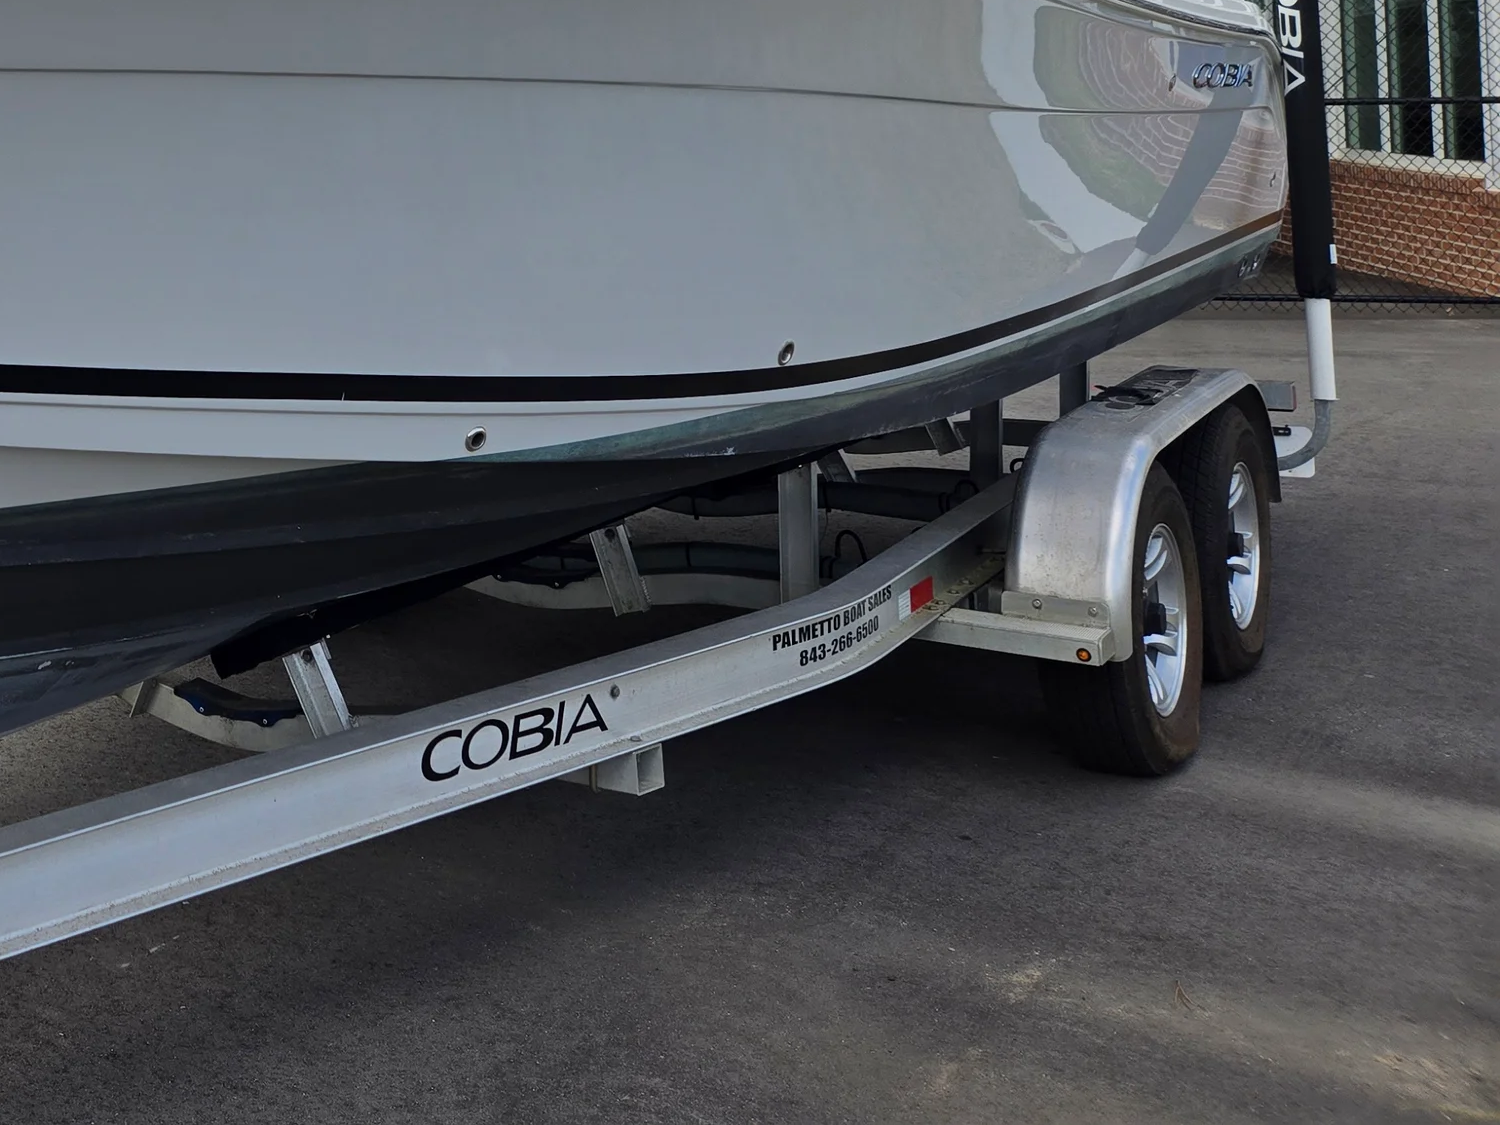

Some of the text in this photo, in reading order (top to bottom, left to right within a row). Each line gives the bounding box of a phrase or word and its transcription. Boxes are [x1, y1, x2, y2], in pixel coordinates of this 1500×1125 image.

[1192, 62, 1253, 88] COBIA
[772, 584, 892, 651] PALMETTO BOAT SALES
[799, 615, 880, 667] 843-266-6500
[421, 693, 609, 782] COBIA
